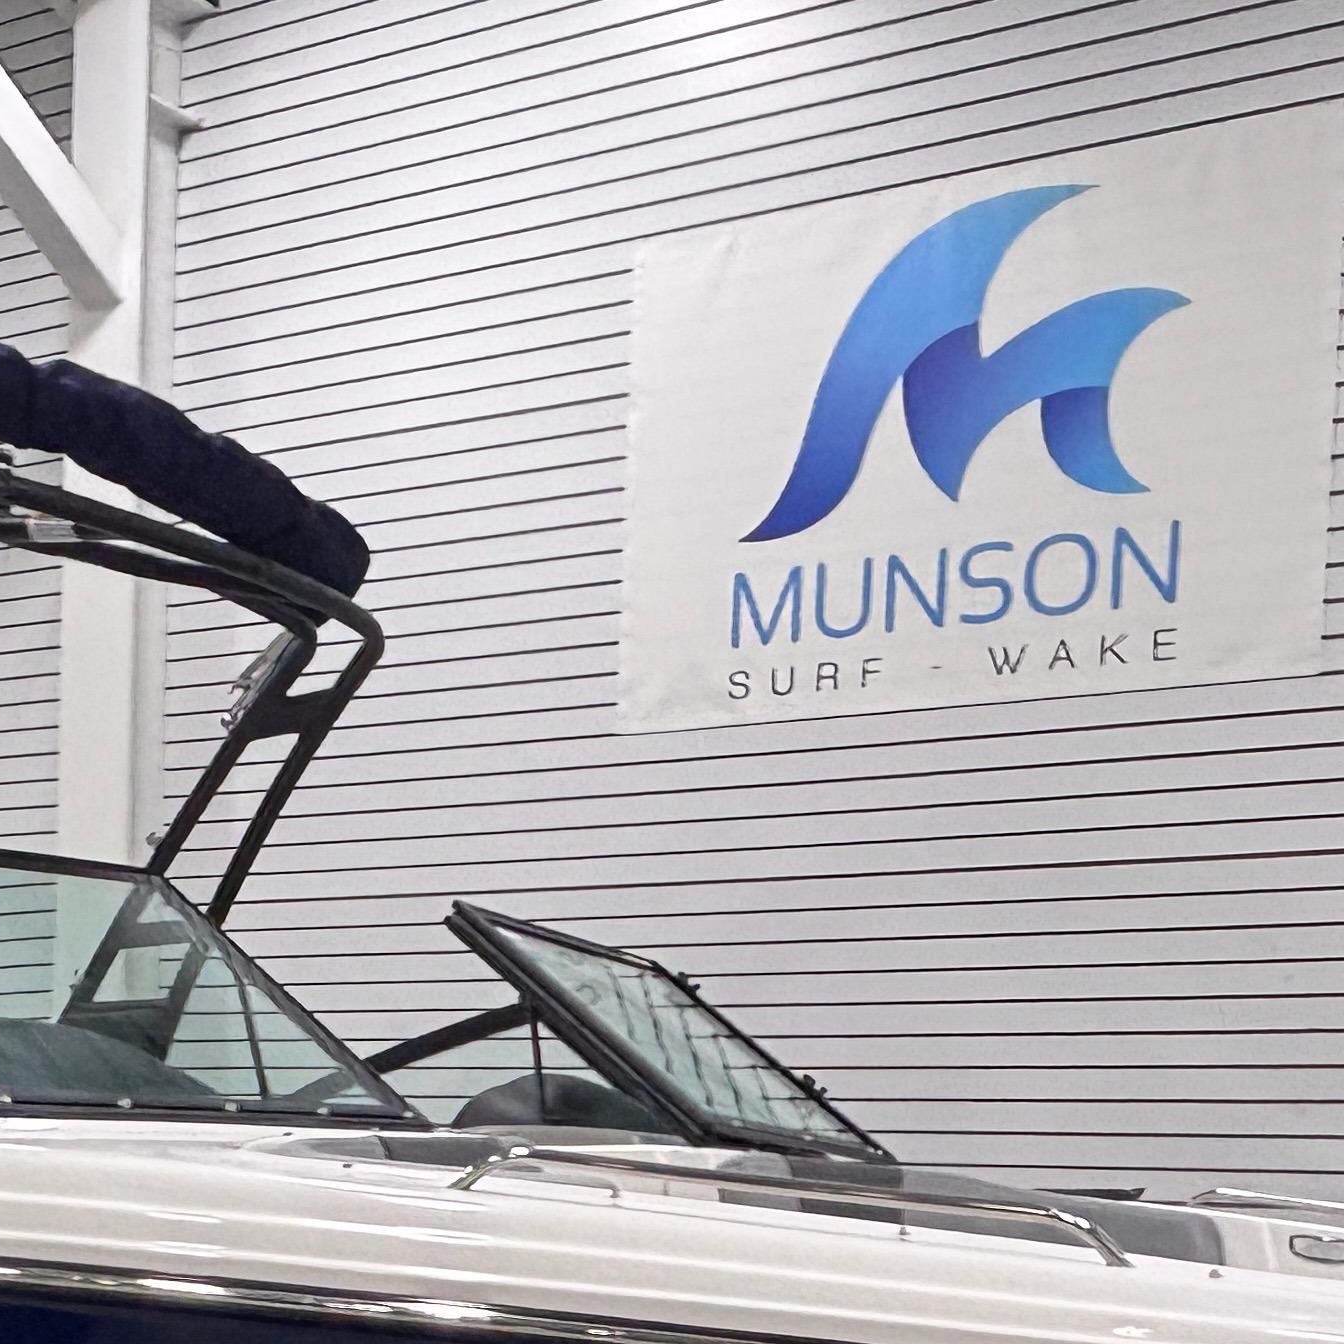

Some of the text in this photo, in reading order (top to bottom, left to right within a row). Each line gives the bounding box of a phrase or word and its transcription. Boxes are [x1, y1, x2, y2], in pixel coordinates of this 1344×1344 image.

[730, 519, 1181, 649] MUNSON
[728, 657, 883, 699] SURF
[988, 627, 1179, 676] WAKE
